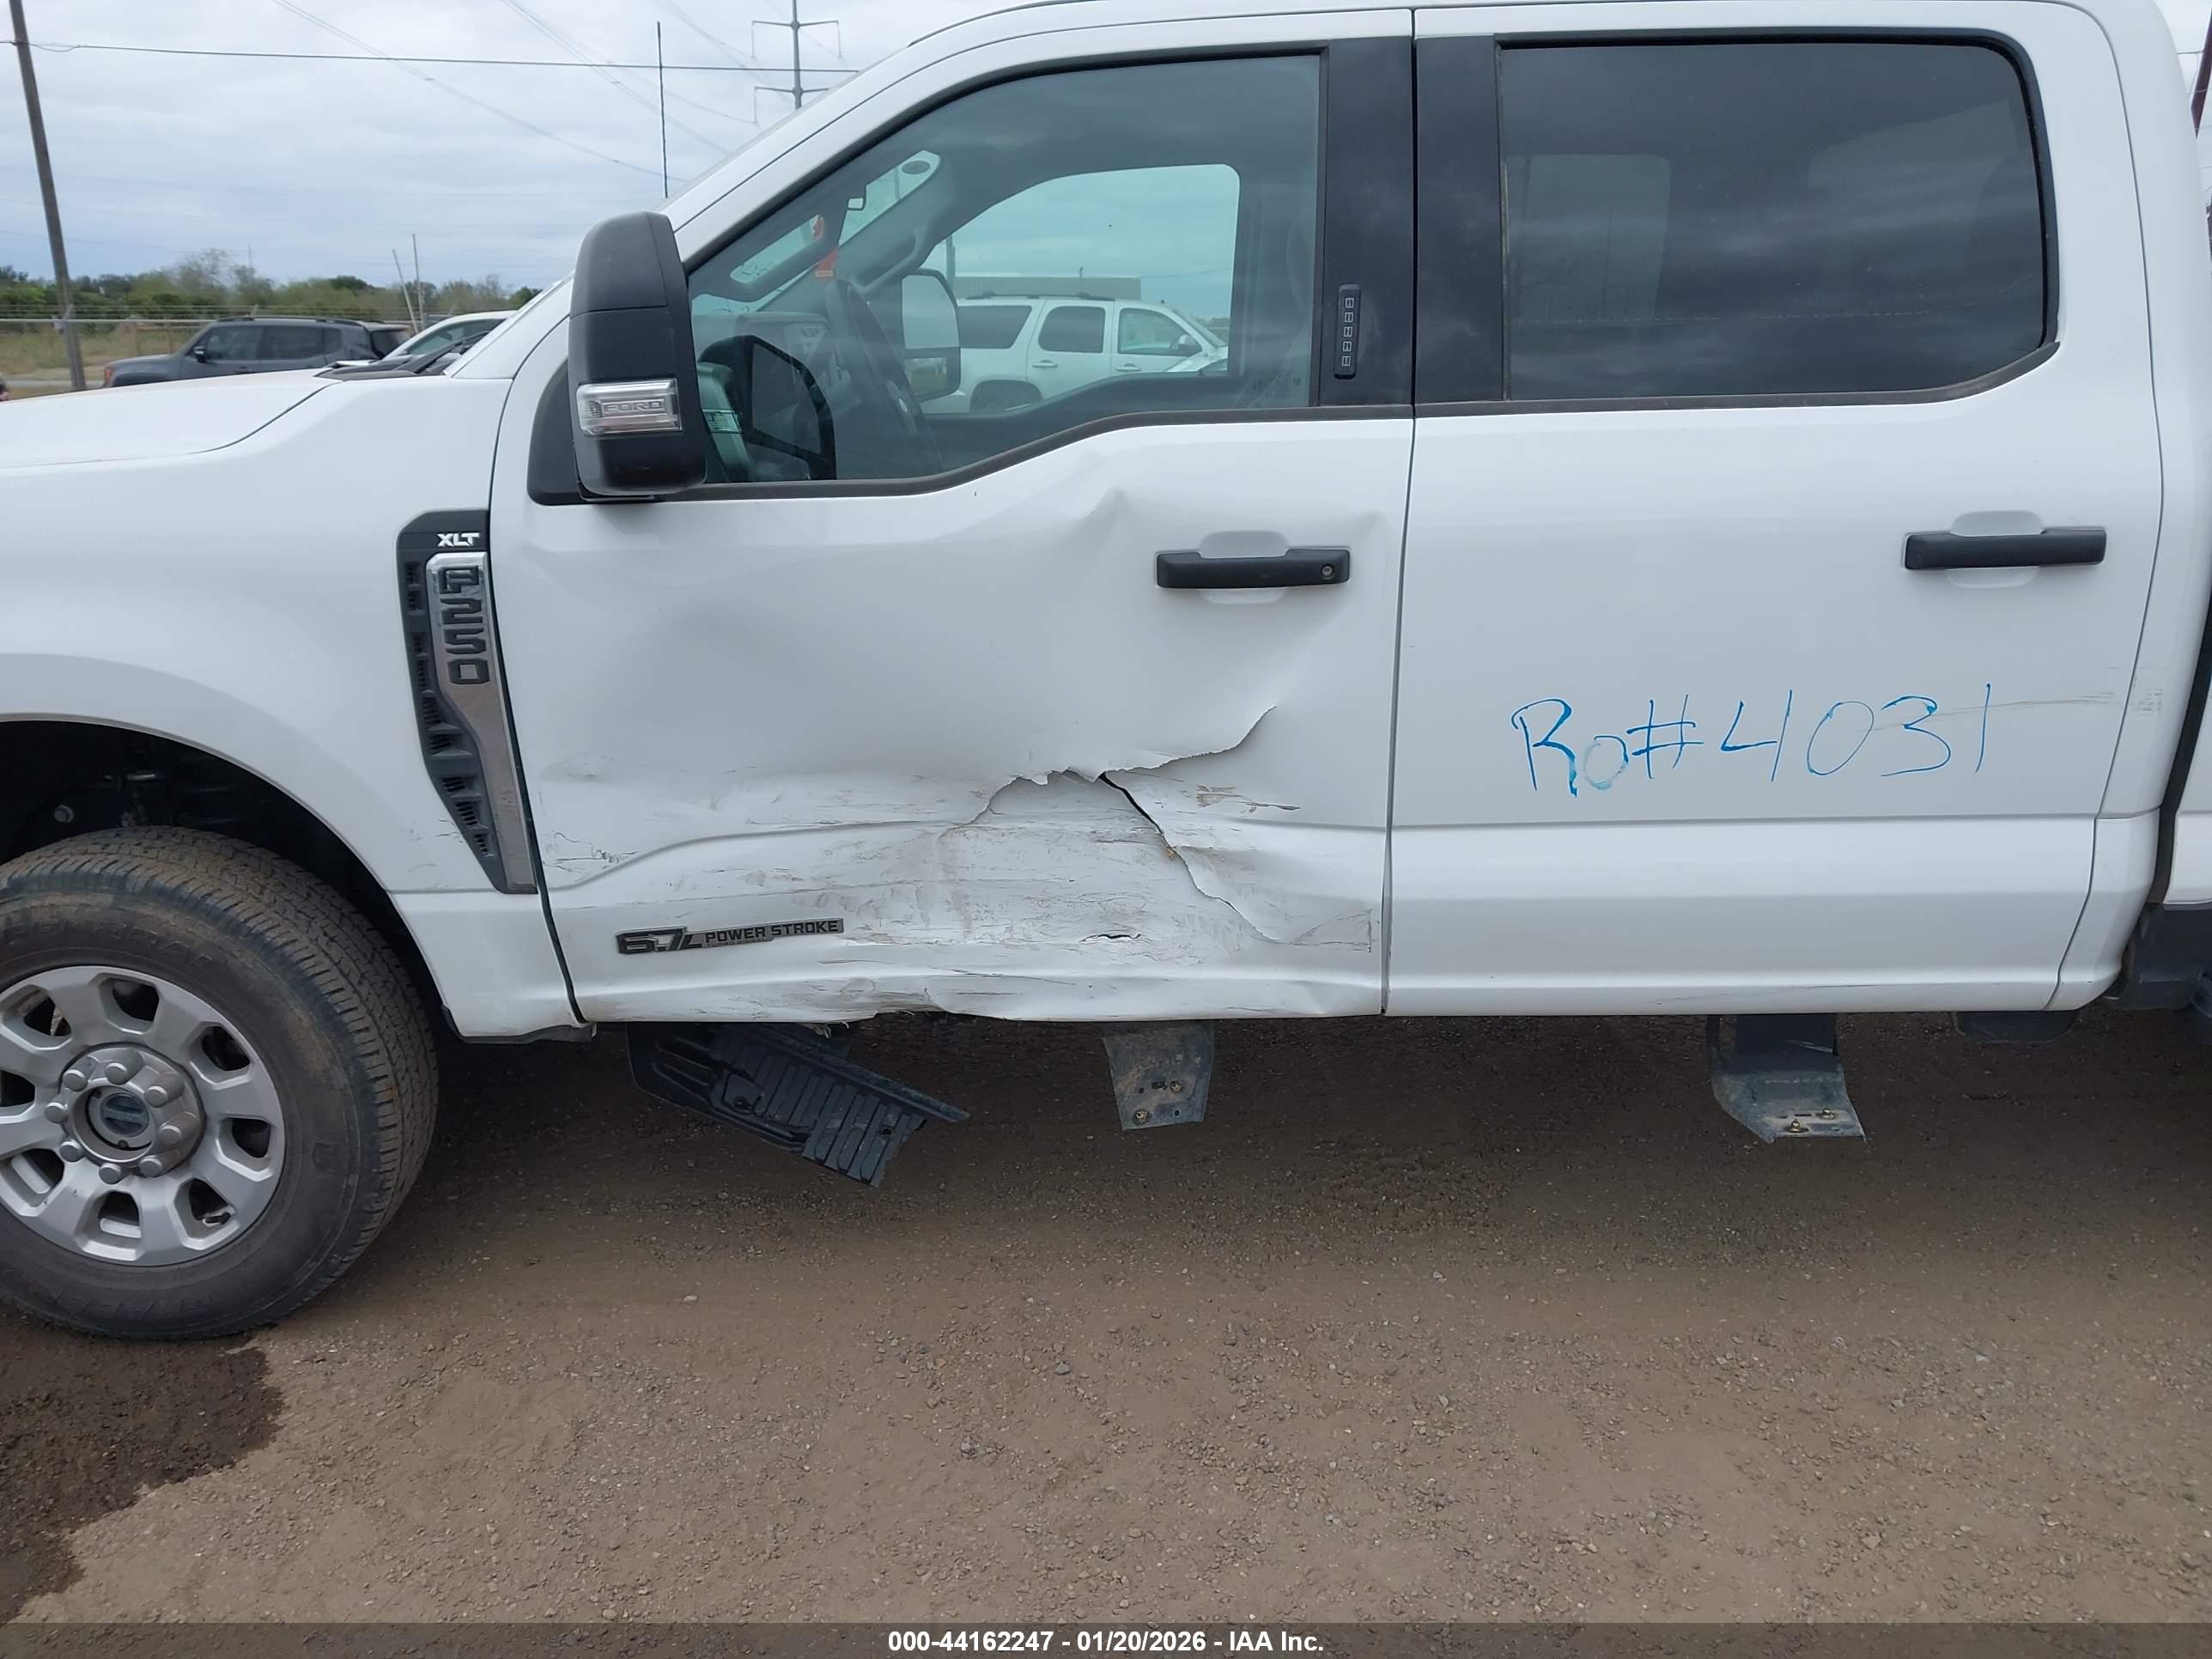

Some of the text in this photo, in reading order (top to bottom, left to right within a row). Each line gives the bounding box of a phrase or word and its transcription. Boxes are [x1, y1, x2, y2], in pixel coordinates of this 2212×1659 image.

[606, 399, 665, 413] FORD
[437, 532, 480, 547] XLT
[439, 565, 490, 684] F250
[617, 927, 702, 954] 6.7L
[704, 926, 767, 944] POWER
[770, 920, 838, 937] STROKE
